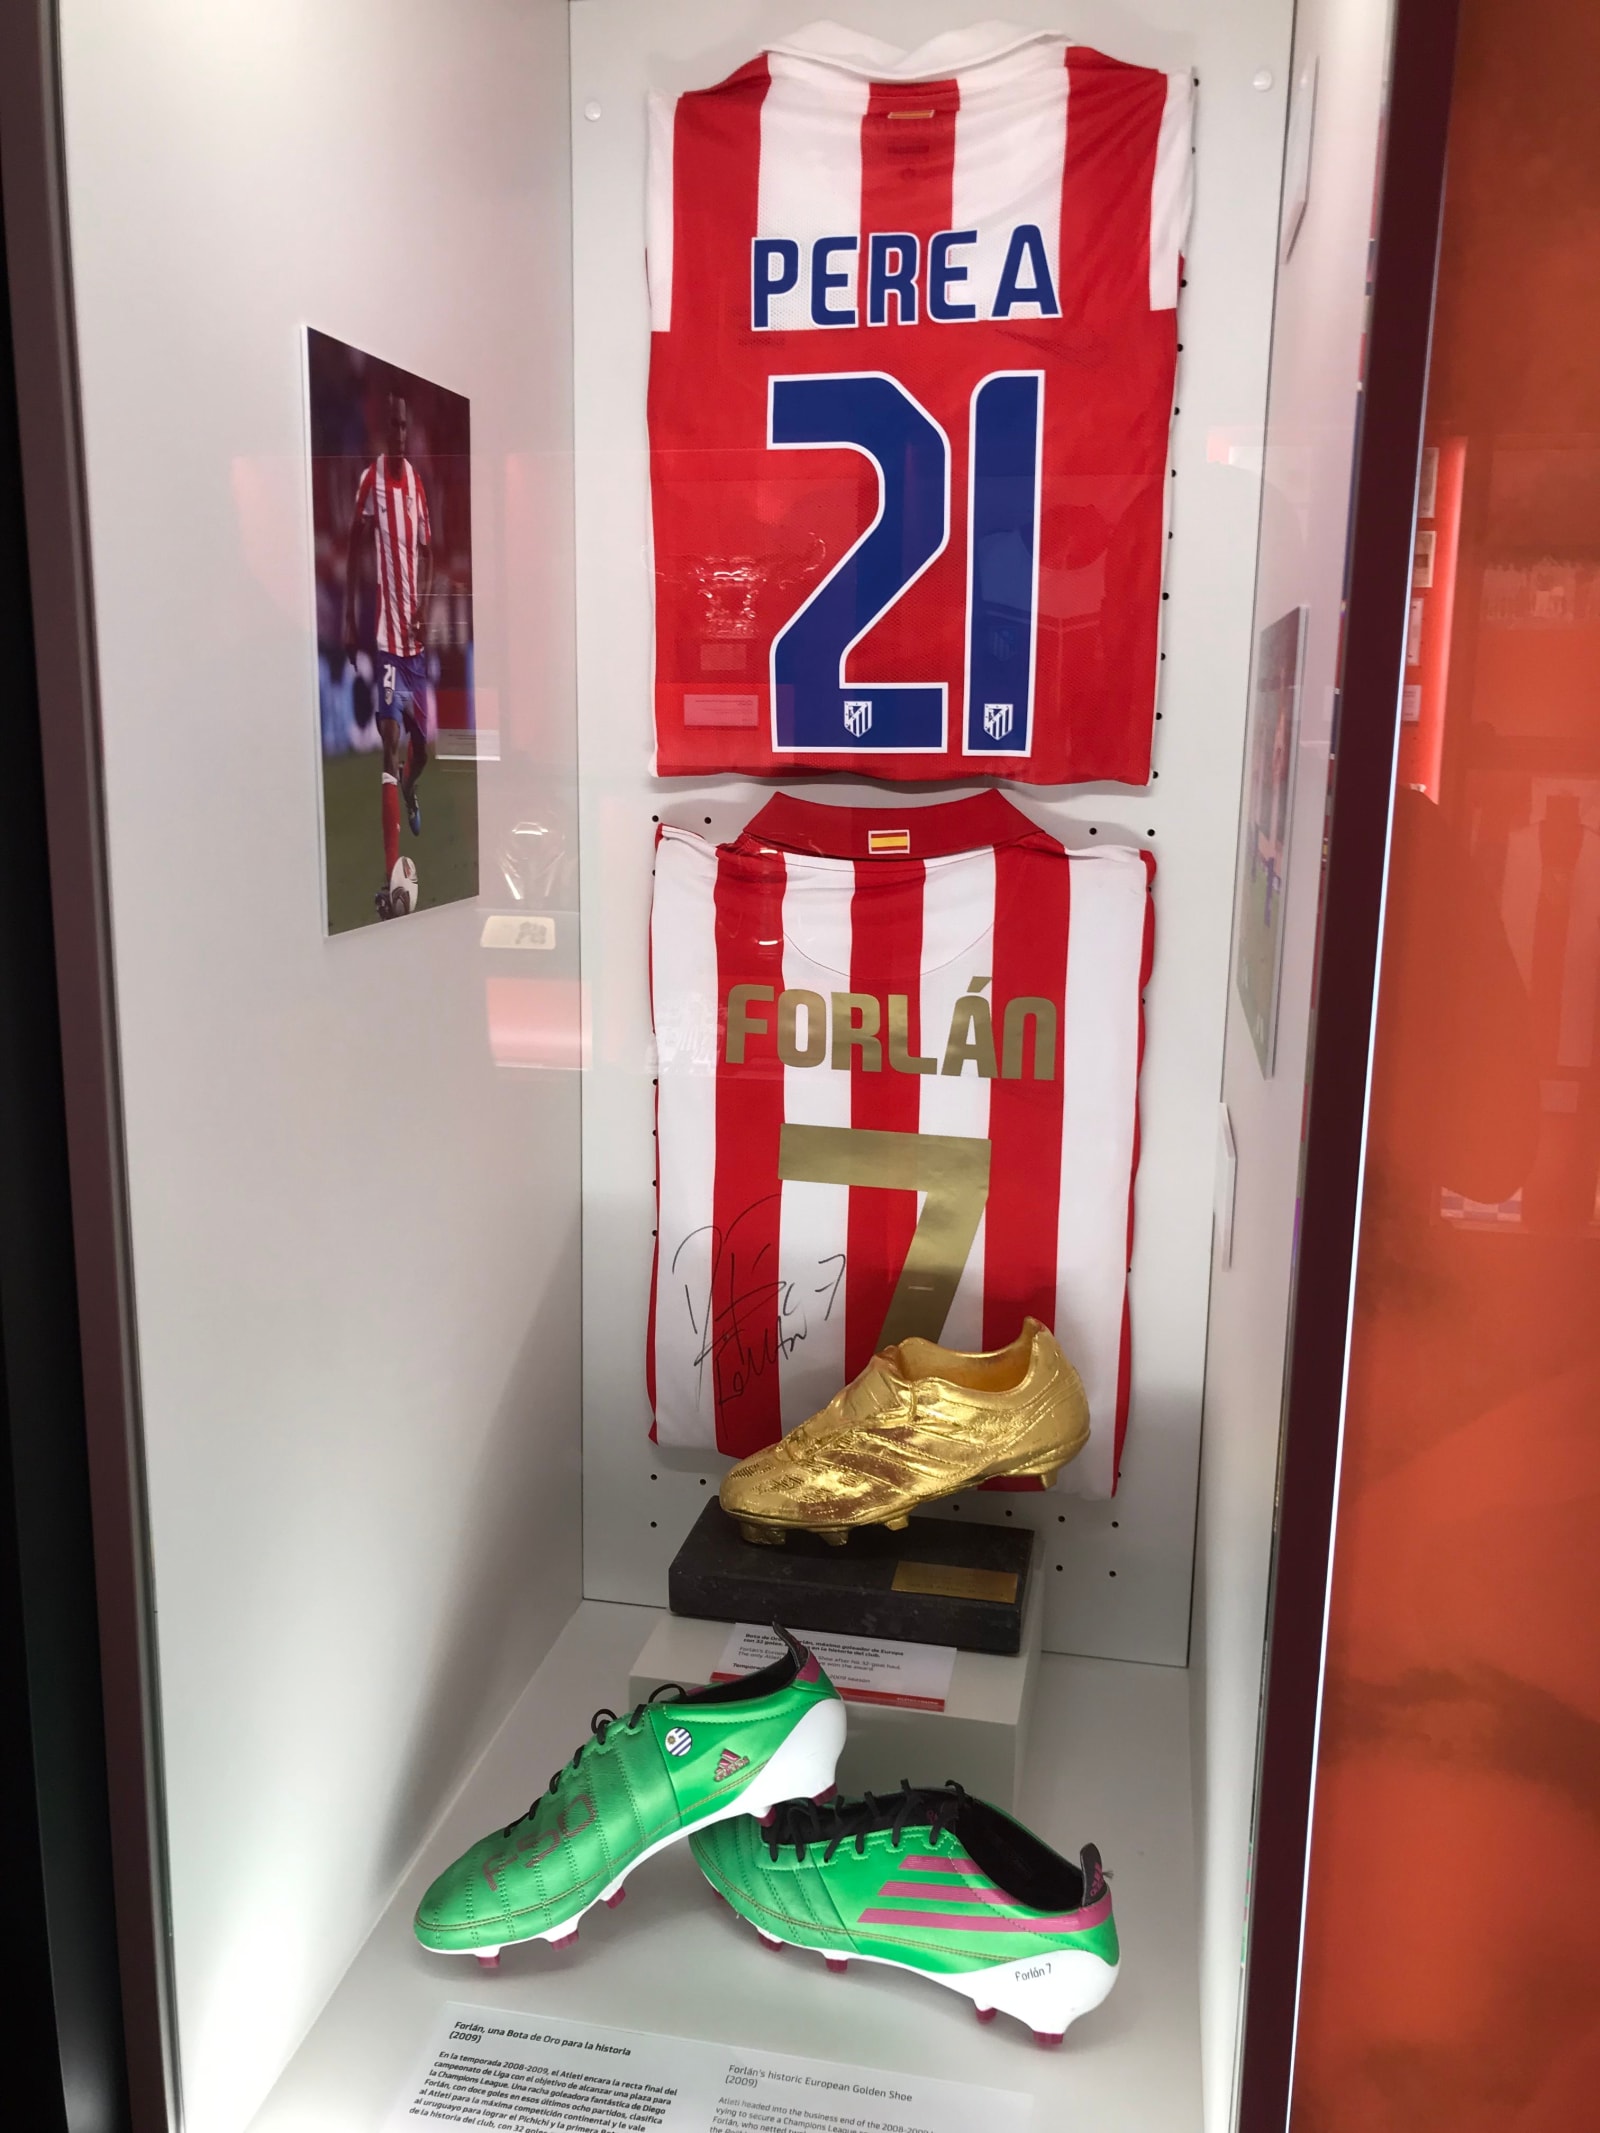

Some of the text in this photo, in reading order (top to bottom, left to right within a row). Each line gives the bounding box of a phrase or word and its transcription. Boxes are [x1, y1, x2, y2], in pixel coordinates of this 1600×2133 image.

[752, 224, 1063, 332] PEREA
[766, 370, 1045, 757] 21
[383, 664, 396, 691] 21
[725, 976, 1057, 1081] FORLÁN
[778, 1123, 991, 1356] 7
[1045, 1962, 1052, 1975] 7
[449, 2031, 482, 2044] (2009)
[454, 2021, 631, 2056] Forlán, una Bota de Oro para la historia
[434, 2061, 481, 2074] campeonato
[482, 2068, 492, 2076] de
[493, 2069, 510, 2079] Liga
[511, 2073, 525, 2081] con
[535, 2076, 567, 2088] objetivo
[567, 2081, 578, 2090] de
[578, 2083, 613, 2095] alcanzar
[613, 2090, 629, 2098] una
[629, 2091, 652, 2102] plaza
[652, 2096, 672, 2105] para
[439, 2051, 449, 2059] En
[450, 2052, 458, 2060] la
[459, 2054, 501, 2067] temporada
[503, 2061, 549, 2076] 2008-2009,
[551, 2069, 559, 2077] el
[560, 2070, 583, 2081] Atleti
[583, 2075, 611, 2085] encara
[621, 2082, 643, 2090] recta
[644, 2084, 663, 2094] final
[664, 2087, 677, 2096] del
[725, 2075, 758, 2088] (2009)
[729, 2064, 913, 2102] Forlán's historic European Golden Shoe
[419, 2088, 427, 2096] al
[428, 2089, 452, 2100] Atleti
[451, 2094, 471, 2103] para
[471, 2096, 480, 2104] la
[480, 2098, 513, 2110] máxima
[513, 2105, 562, 2119] competición
[563, 2112, 611, 2126] continental
[611, 2120, 618, 2128] y
[618, 2120, 627, 2128] le
[628, 2123, 646, 2133] vale
[424, 2078, 663, 2125] Forlán, con doce goles en esos últimos ocho partidos, clasifica
[429, 2069, 666, 2116] la Champions League. Una racha goleadora fantástica de Diego
[413, 2097, 422, 2105] al
[423, 2100, 461, 2112] uruguayo
[462, 2106, 481, 2115] para
[482, 2107, 508, 2119] lograr
[518, 2115, 550, 2126] Pichichi
[549, 2121, 556, 2129] y
[557, 2121, 565, 2129] la
[420, 2107, 429, 2116] la
[430, 2110, 461, 2122] historia
[462, 2117, 476, 2125] del
[476, 2119, 496, 2129] club,
[497, 2123, 512, 2131] con
[712, 2116, 739, 2128] Forlán,
[741, 2122, 759, 2130] who
[716, 2107, 737, 2118] vying
[749, 2113, 775, 2122] secure
[783, 2117, 826, 2131] Champions
[718, 2097, 740, 2106] Atleti
[742, 2100, 770, 2112] headed
[772, 2106, 787, 2114] into
[789, 2108, 802, 2117] the
[804, 2110, 838, 2123] business
[840, 2117, 855, 2125] end
[856, 2119, 866, 2127] of
[867, 2121, 880, 2130] the
